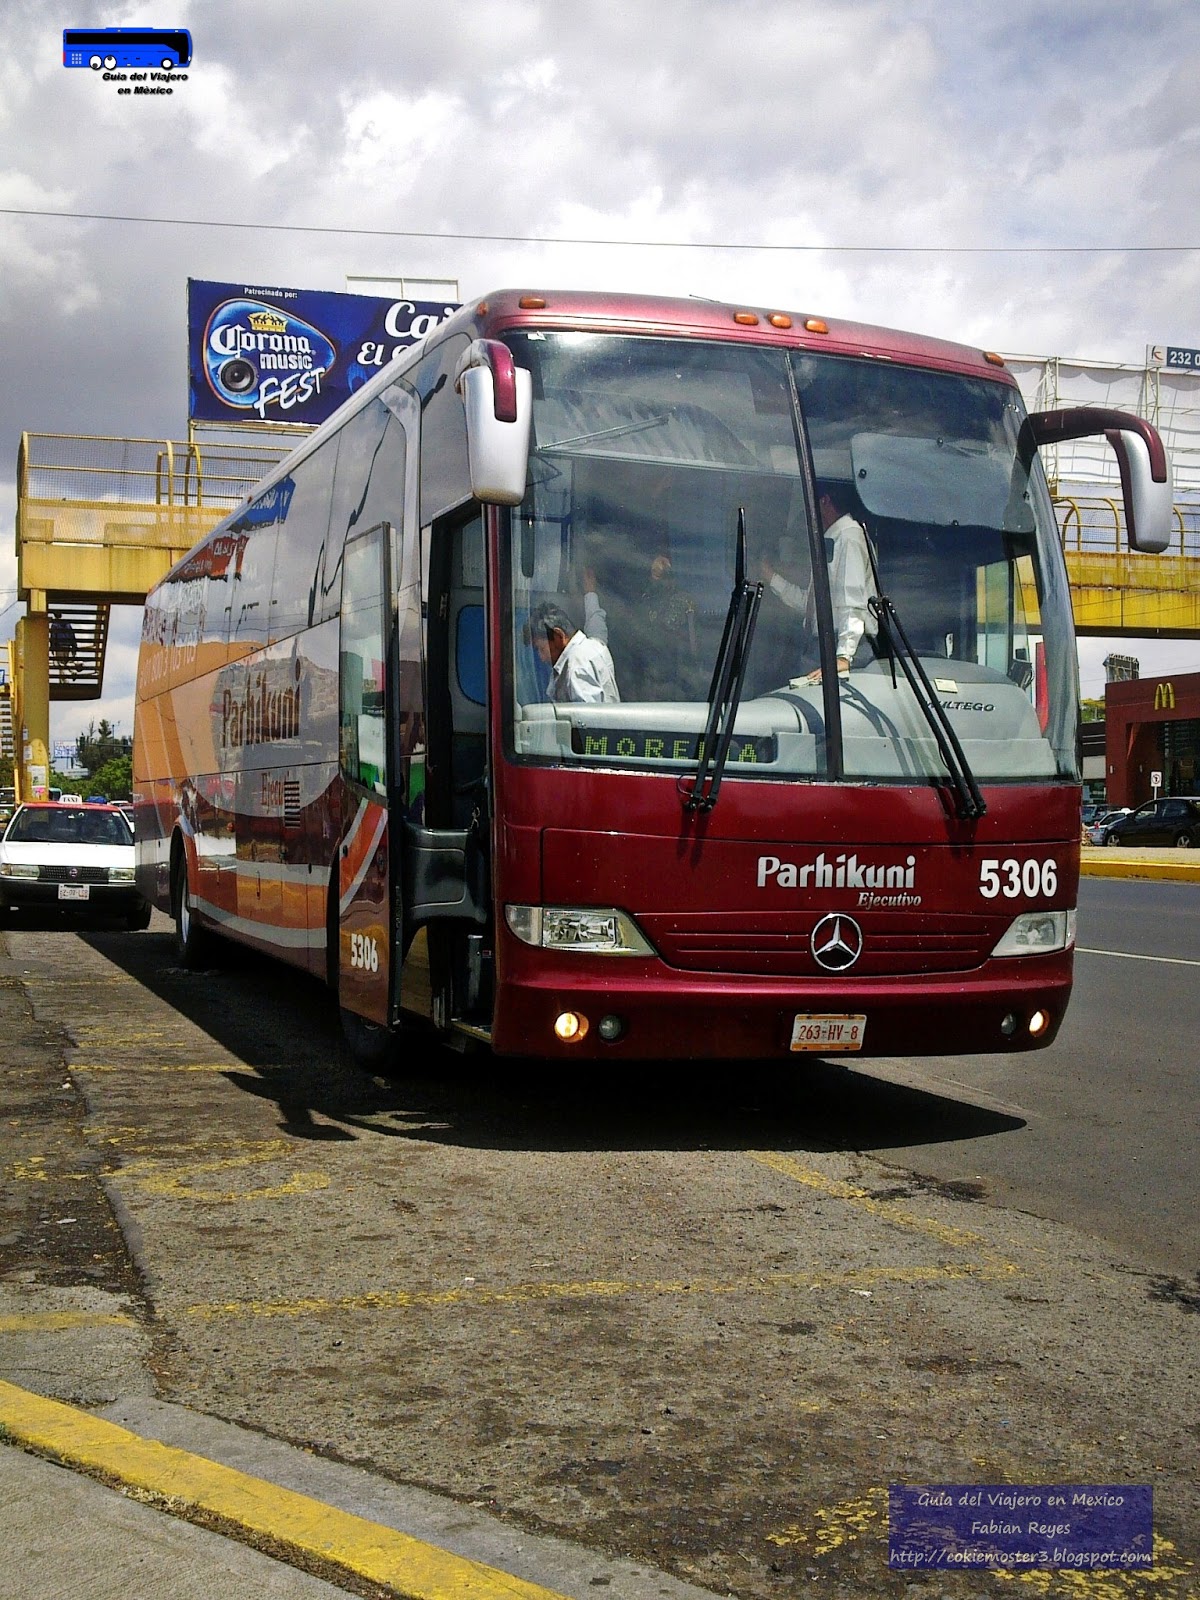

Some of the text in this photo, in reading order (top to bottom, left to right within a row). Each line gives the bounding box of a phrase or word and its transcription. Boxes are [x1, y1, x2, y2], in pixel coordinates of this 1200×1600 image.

[244, 287, 298, 299] Patrocinado por:
[210, 324, 312, 358] Corona
[356, 342, 385, 365] El
[261, 351, 313, 370] music
[1169, 351, 1191, 365] 232
[254, 367, 325, 419] FEST
[222, 658, 301, 749] Parhikuni
[757, 853, 916, 888] Parhikuni
[979, 859, 1057, 898] 5306
[857, 892, 922, 910] Ejecutivo
[351, 933, 378, 972] 5306
[799, 1025, 858, 1040] 263-HV-8
